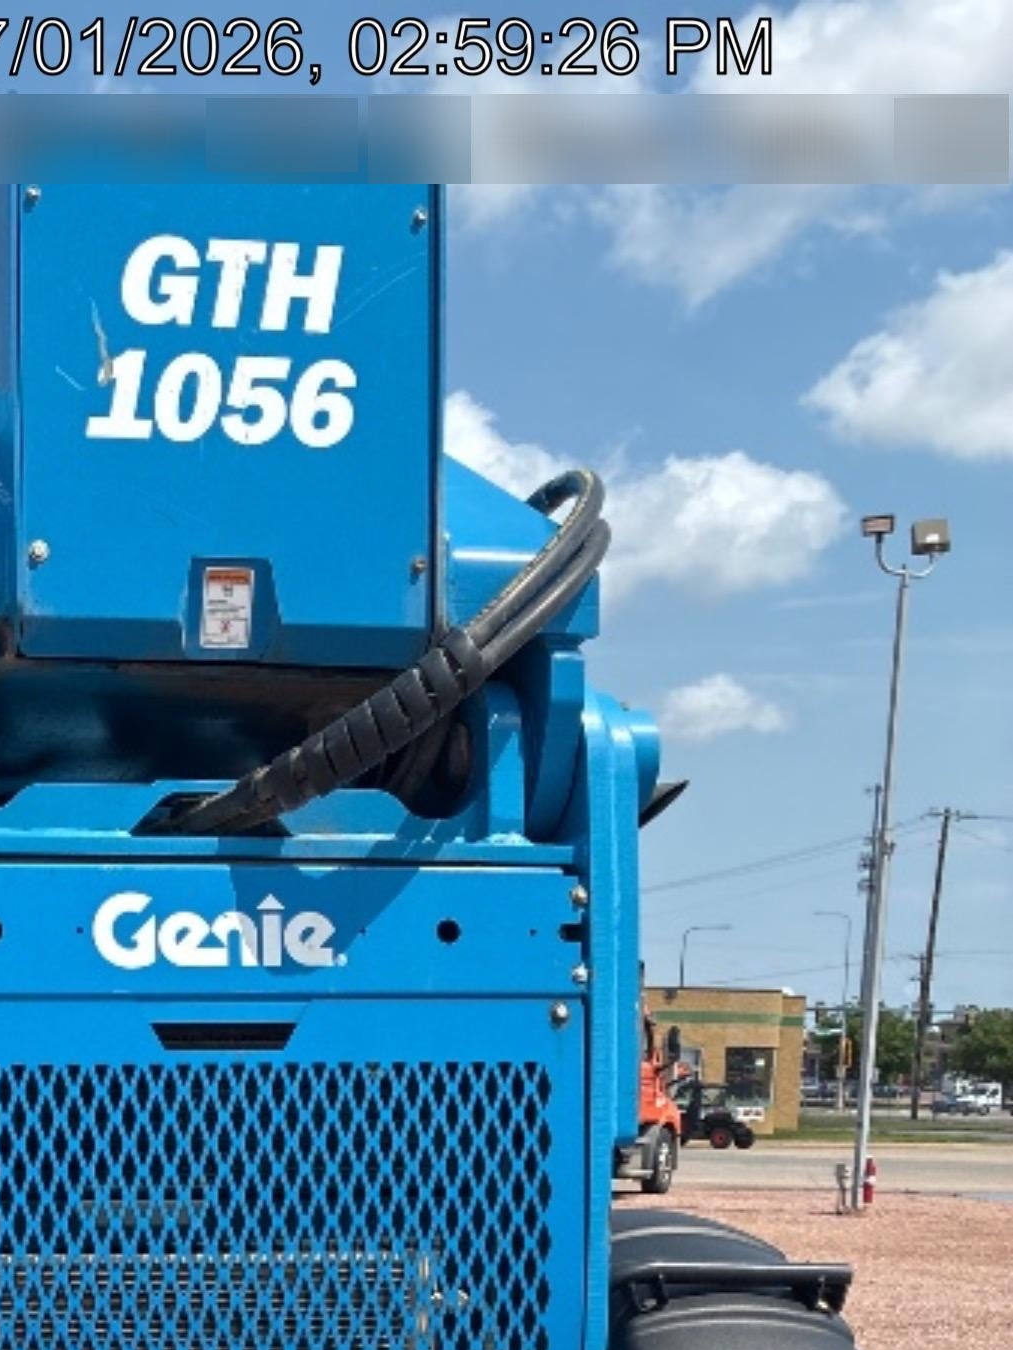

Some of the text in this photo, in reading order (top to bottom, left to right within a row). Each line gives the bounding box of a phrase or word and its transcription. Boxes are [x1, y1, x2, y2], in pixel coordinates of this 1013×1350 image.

[121, 233, 344, 334] GTH
[85, 348, 358, 449] 1056
[92, 891, 337, 971] Genie
